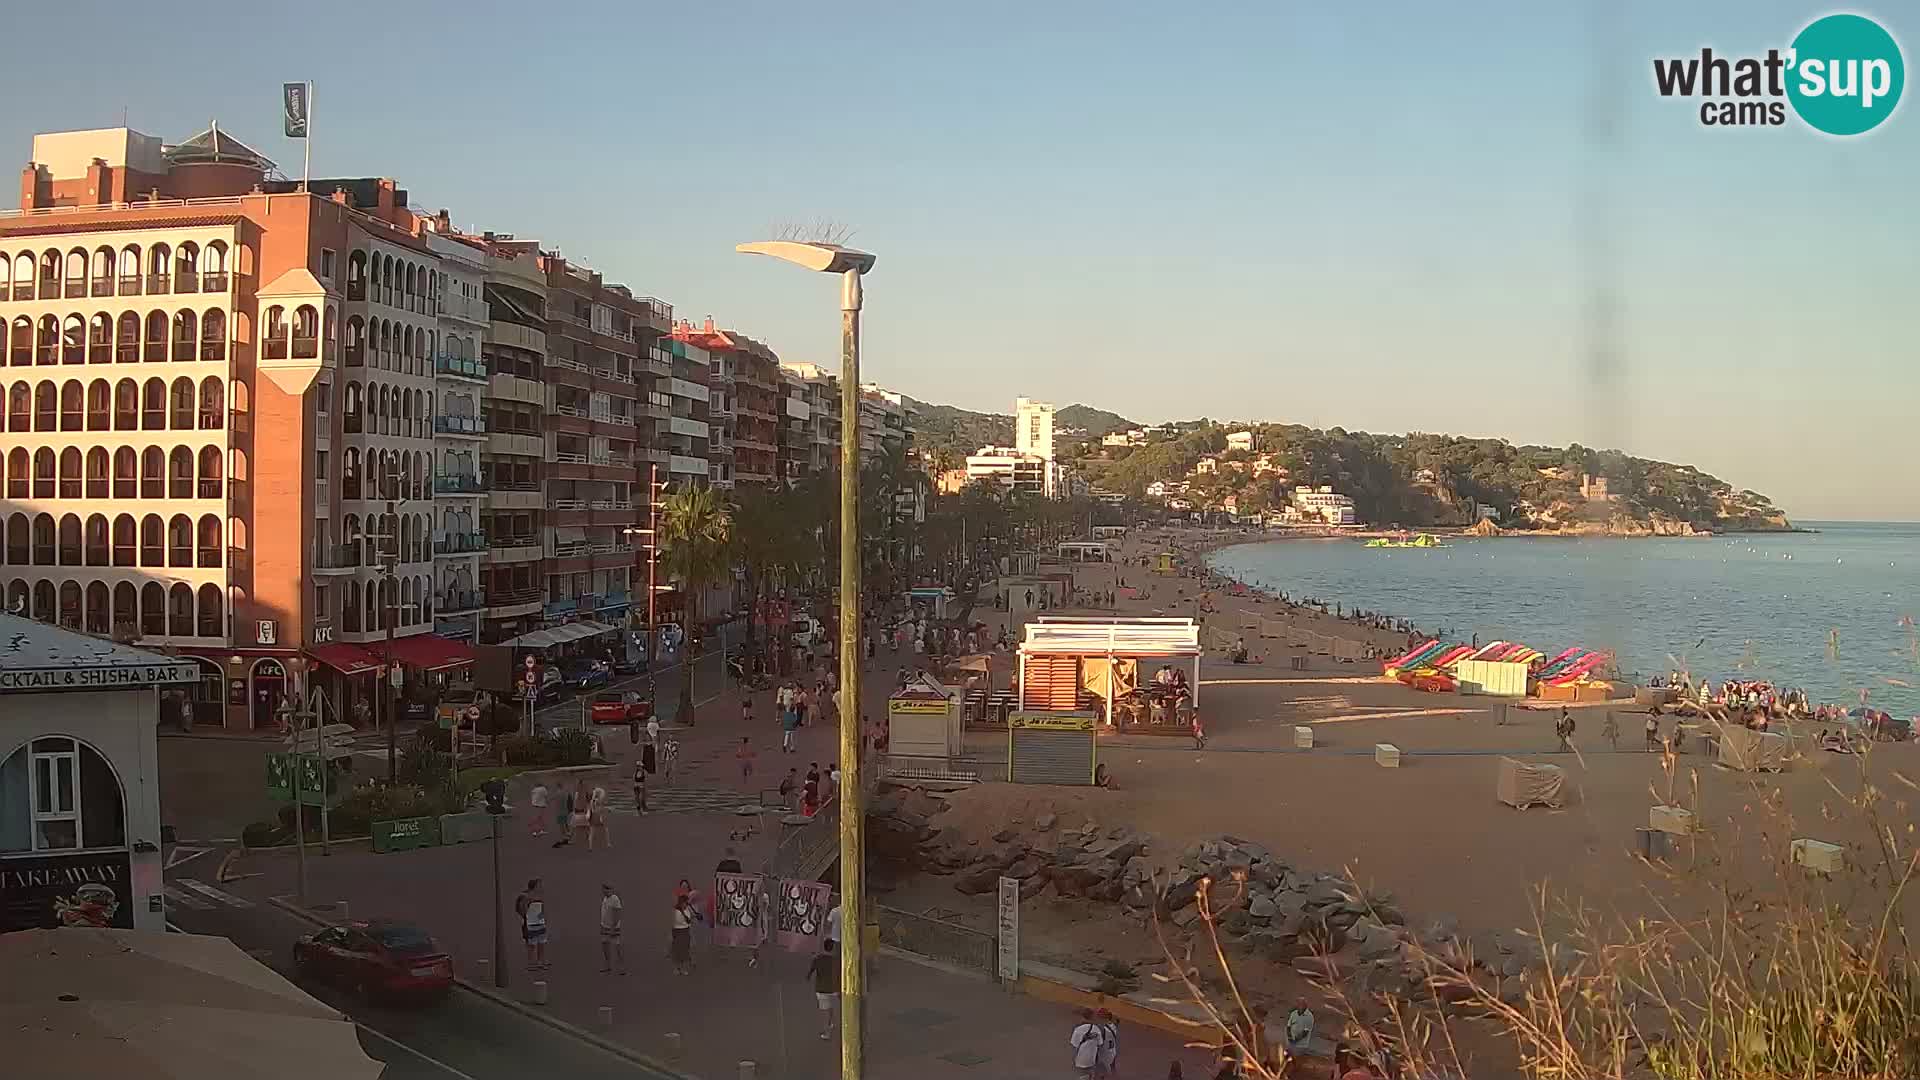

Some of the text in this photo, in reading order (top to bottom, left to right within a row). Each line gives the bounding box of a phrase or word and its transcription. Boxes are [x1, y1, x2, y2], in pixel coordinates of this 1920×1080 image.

[315, 626, 332, 643] KFC
[64, 671, 75, 684] &
[80, 669, 141, 684] SHISHA
[147, 667, 179, 682] BAR
[259, 664, 282, 676] KFC
